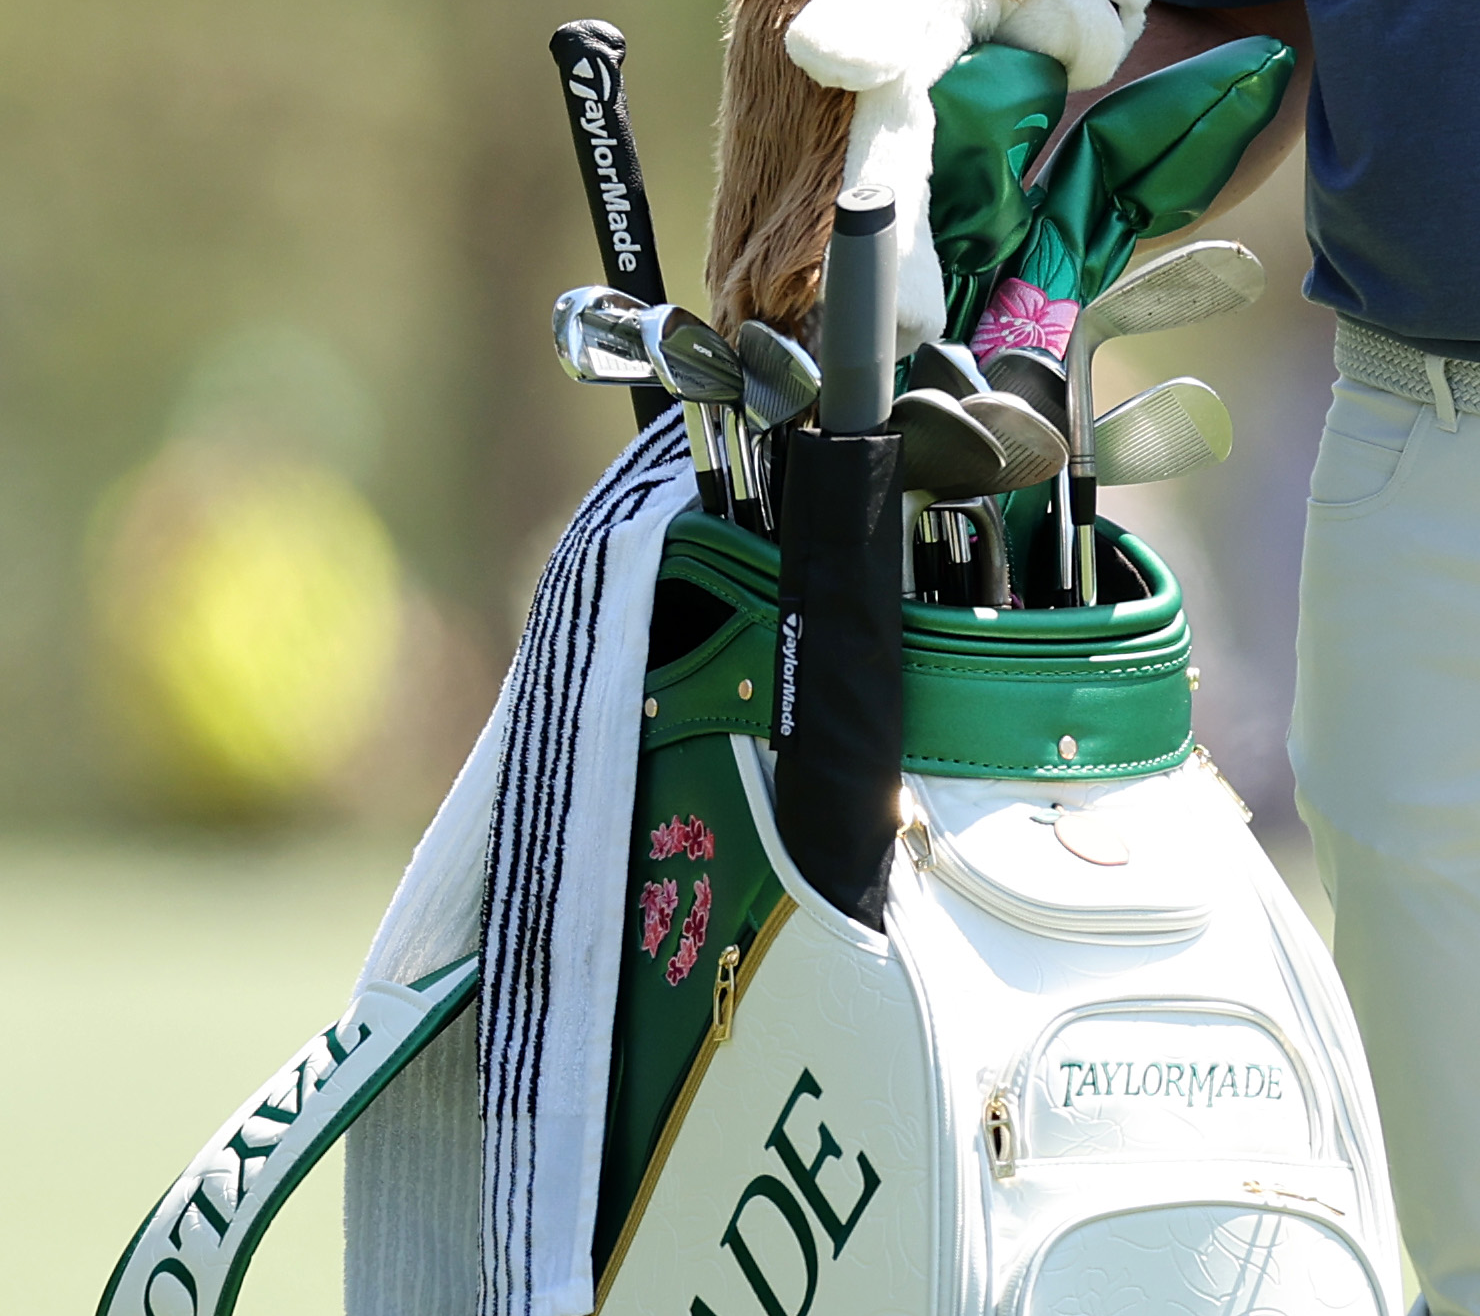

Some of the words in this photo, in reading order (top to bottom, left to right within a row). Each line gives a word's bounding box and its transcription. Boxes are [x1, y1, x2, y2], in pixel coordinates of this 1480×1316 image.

[569, 57, 641, 272] TaylorMade
[781, 613, 803, 736] TaylorMade
[1060, 1061, 1283, 1107] TAYLORMADE
